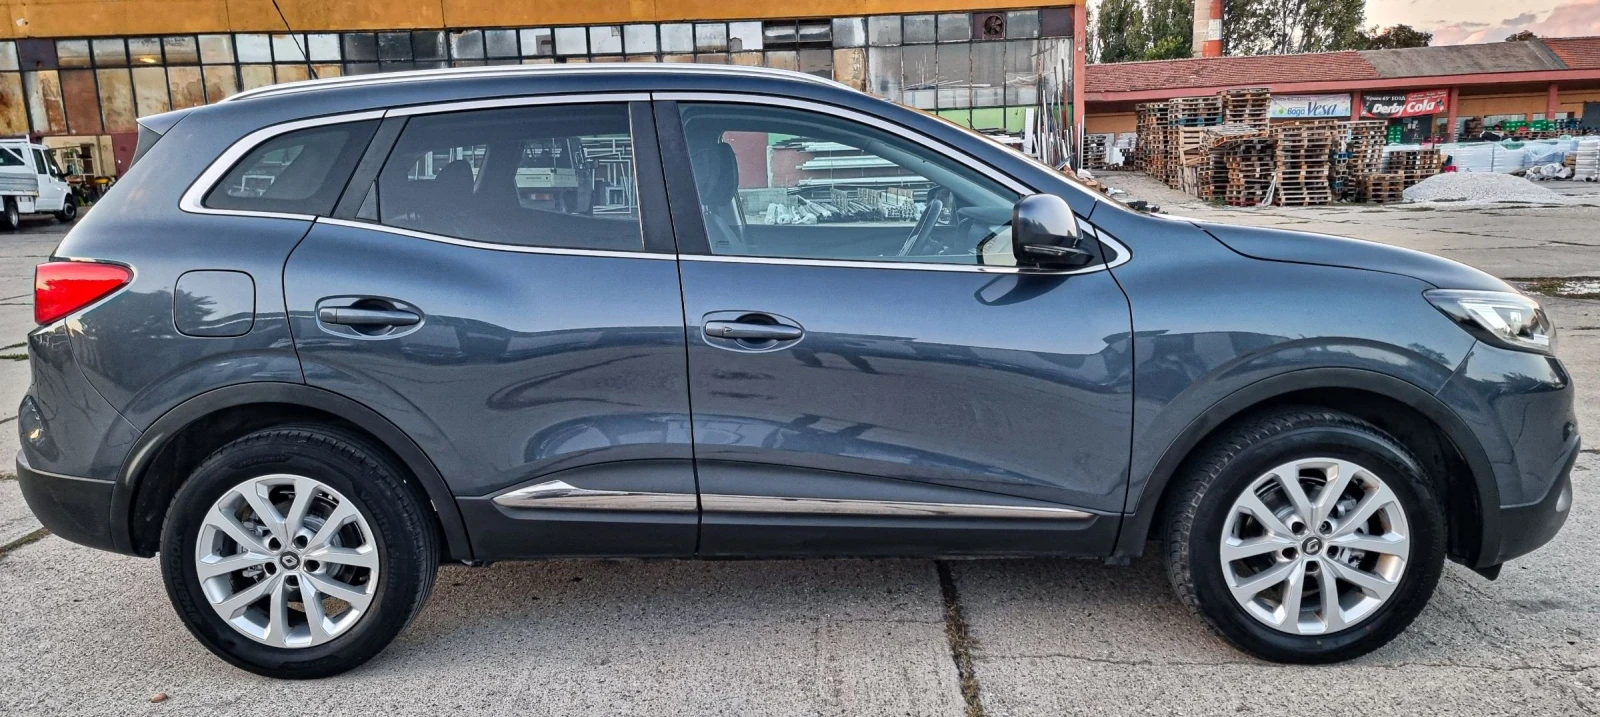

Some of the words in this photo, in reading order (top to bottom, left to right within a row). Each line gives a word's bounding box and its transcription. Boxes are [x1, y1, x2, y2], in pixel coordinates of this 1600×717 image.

[1307, 101, 1338, 116] Vesa
[1371, 102, 1406, 117] Derby
[1406, 98, 1436, 113] Cola
